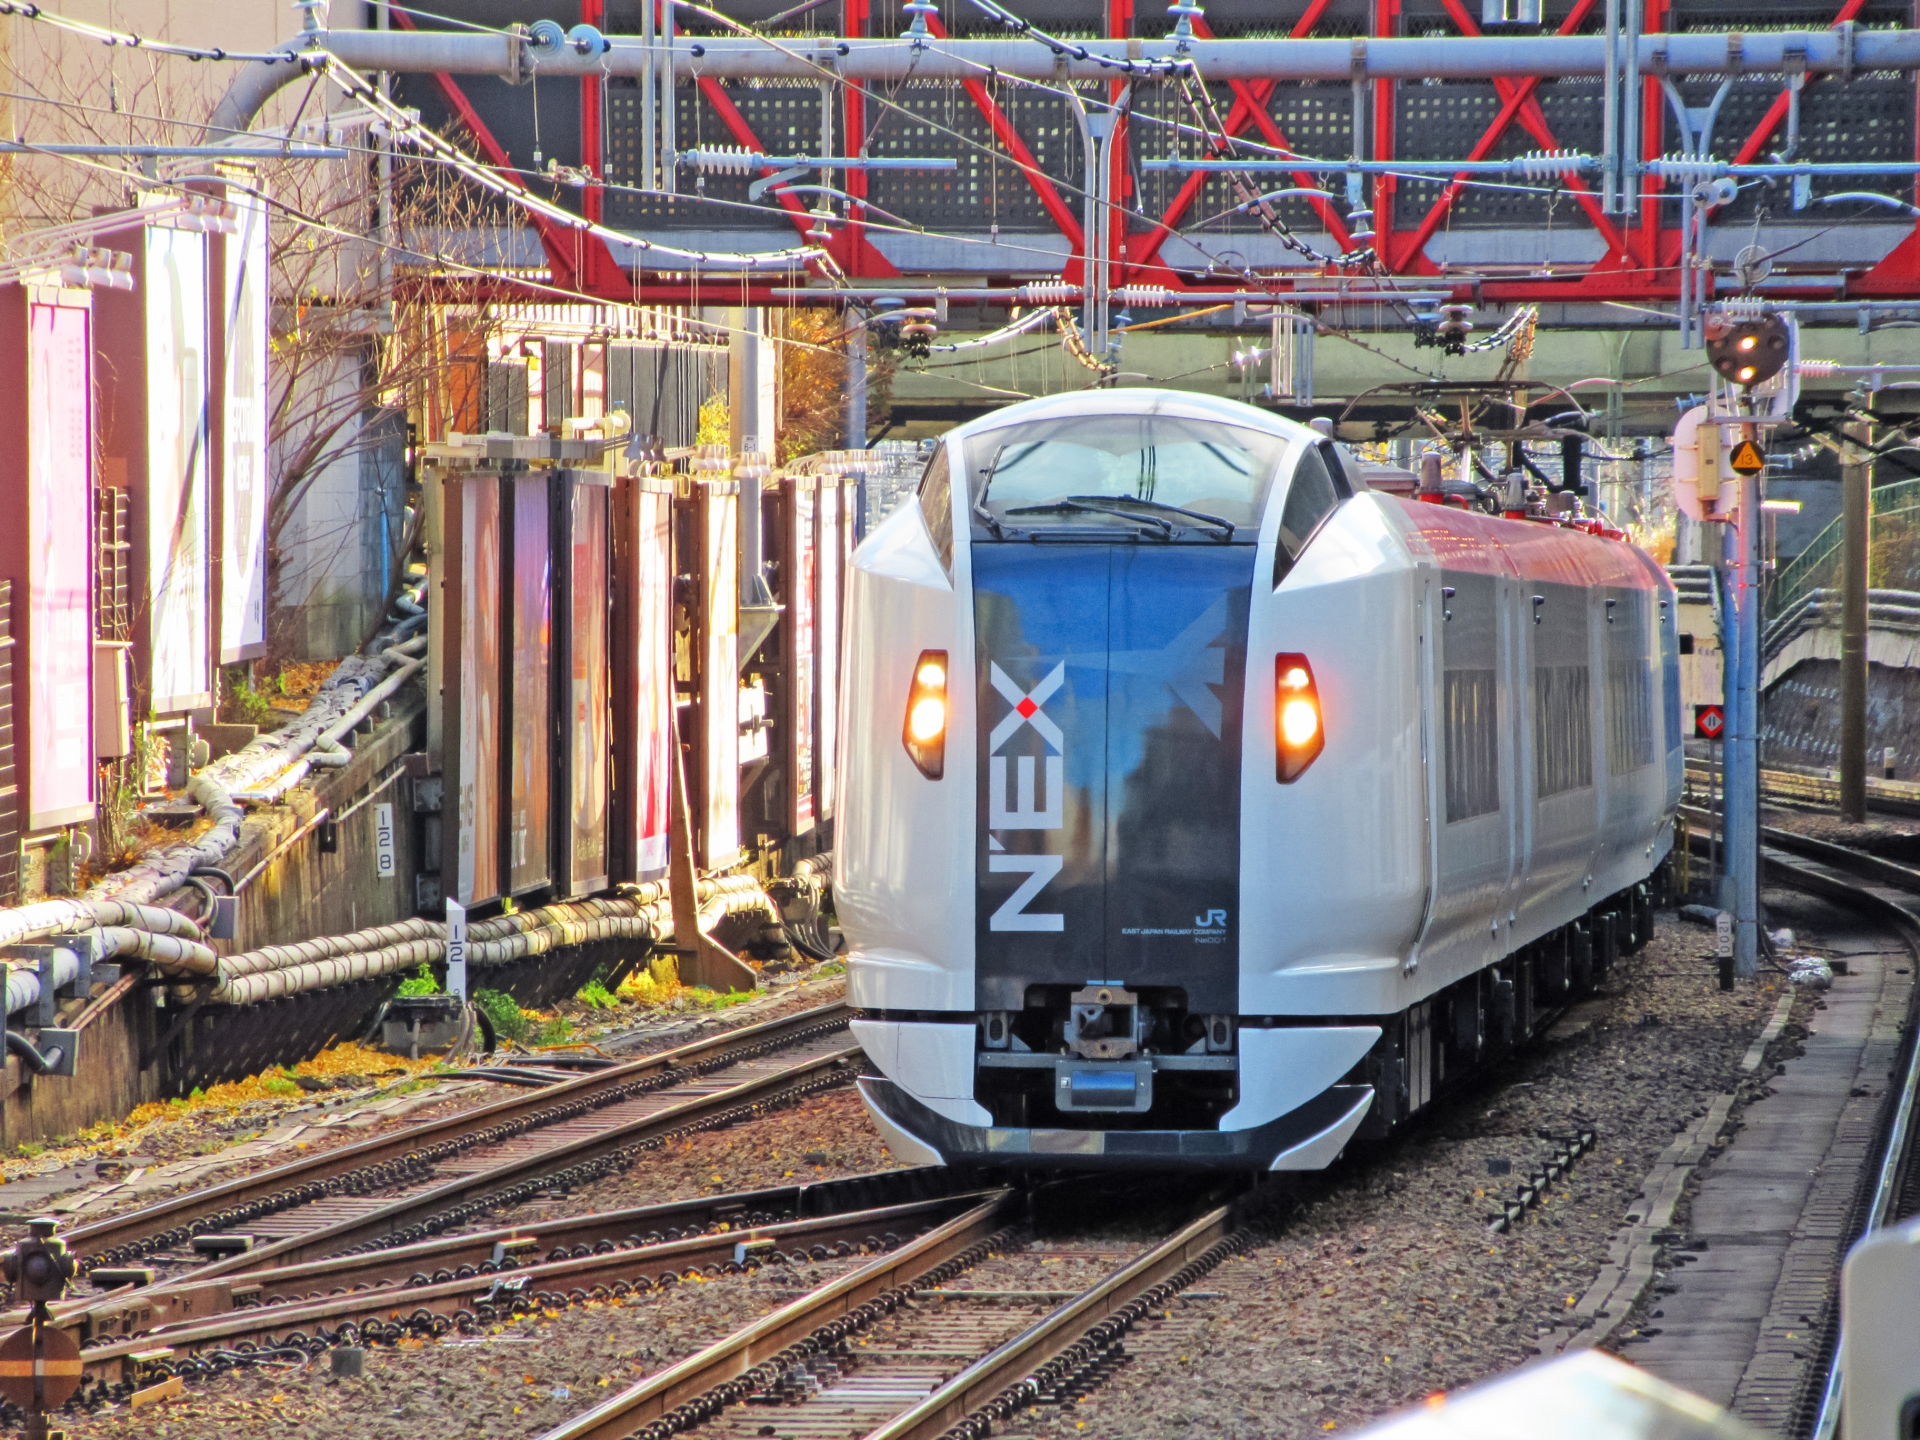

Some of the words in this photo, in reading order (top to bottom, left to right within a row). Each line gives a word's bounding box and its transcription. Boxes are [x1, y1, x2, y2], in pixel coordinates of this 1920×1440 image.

[744, 442, 756, 451] 6-1
[1741, 453, 1754, 466] 13
[1195, 909, 1227, 927] JR
[1719, 921, 1731, 954] 1200
